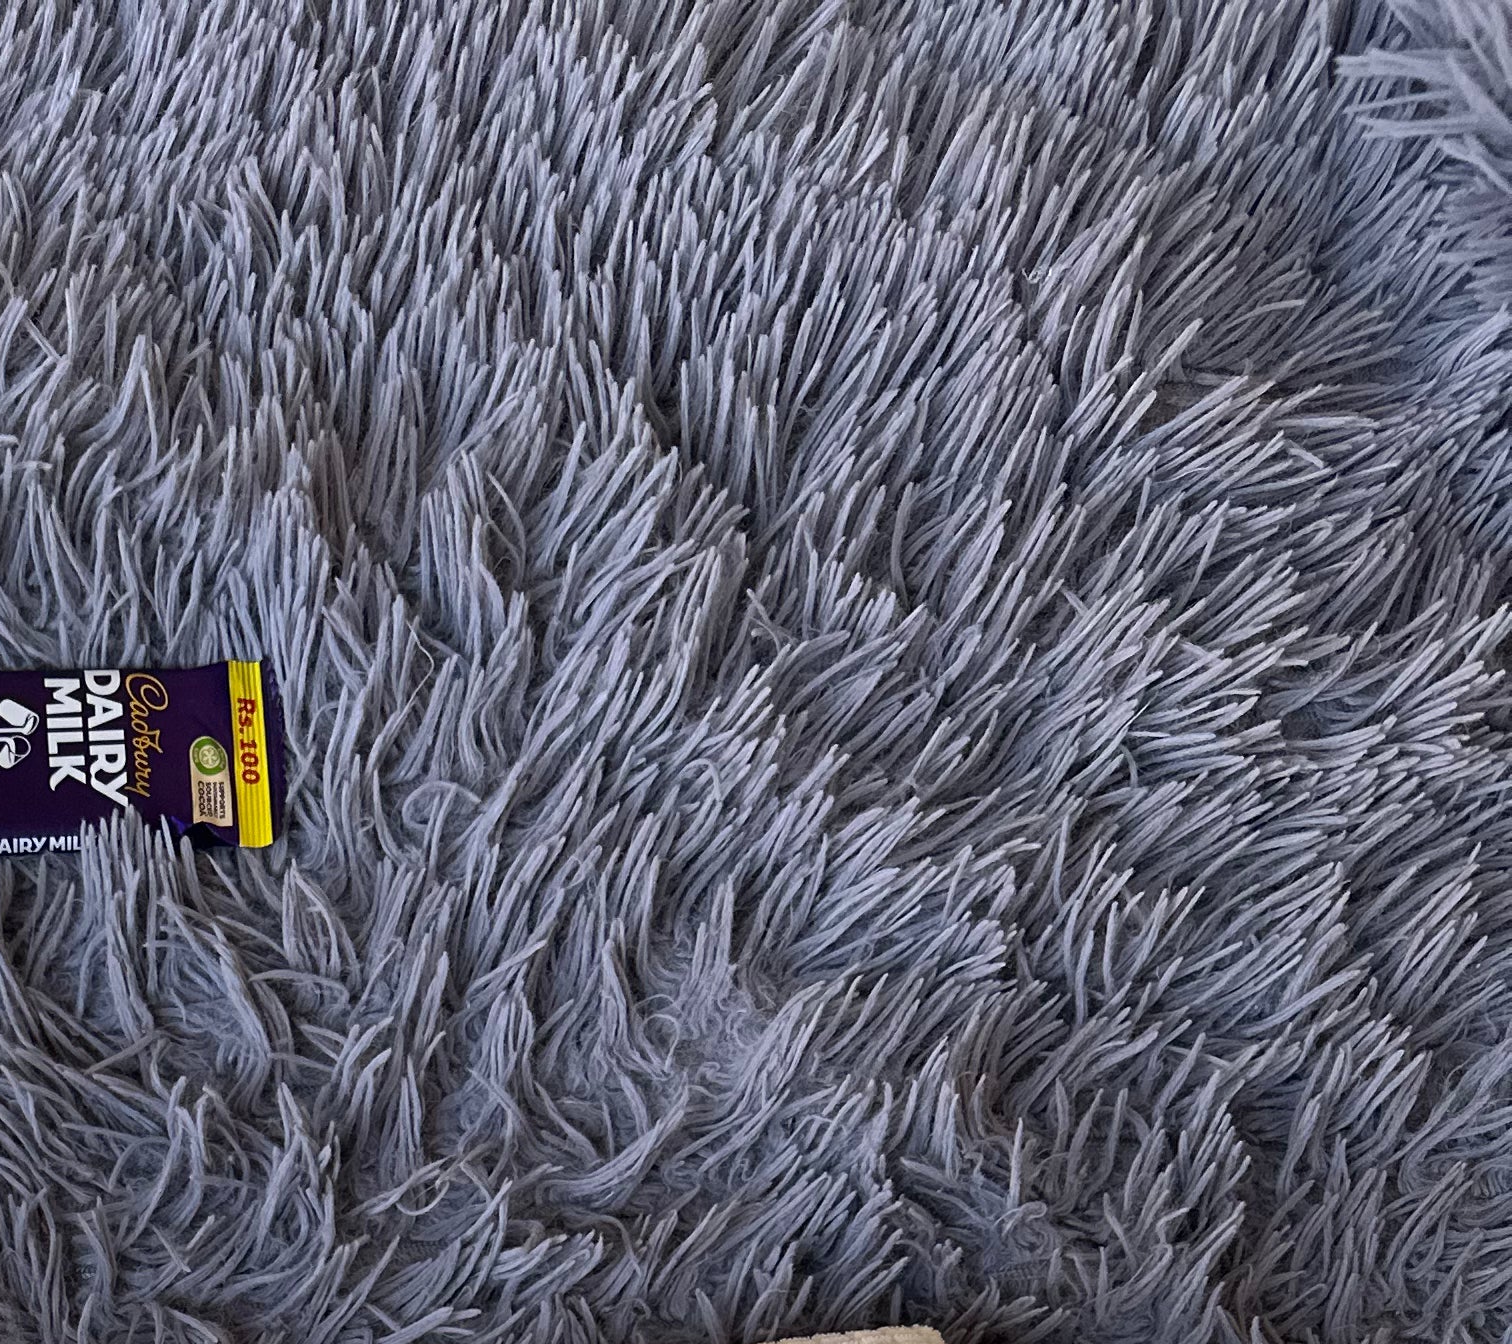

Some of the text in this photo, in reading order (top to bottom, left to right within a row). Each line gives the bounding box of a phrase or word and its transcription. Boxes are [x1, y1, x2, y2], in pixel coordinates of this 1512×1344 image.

[43, 677, 87, 792] MILK
[84, 669, 129, 808] DAIRY
[124, 672, 169, 798] Cadbury
[197, 780, 207, 817] COCOA
